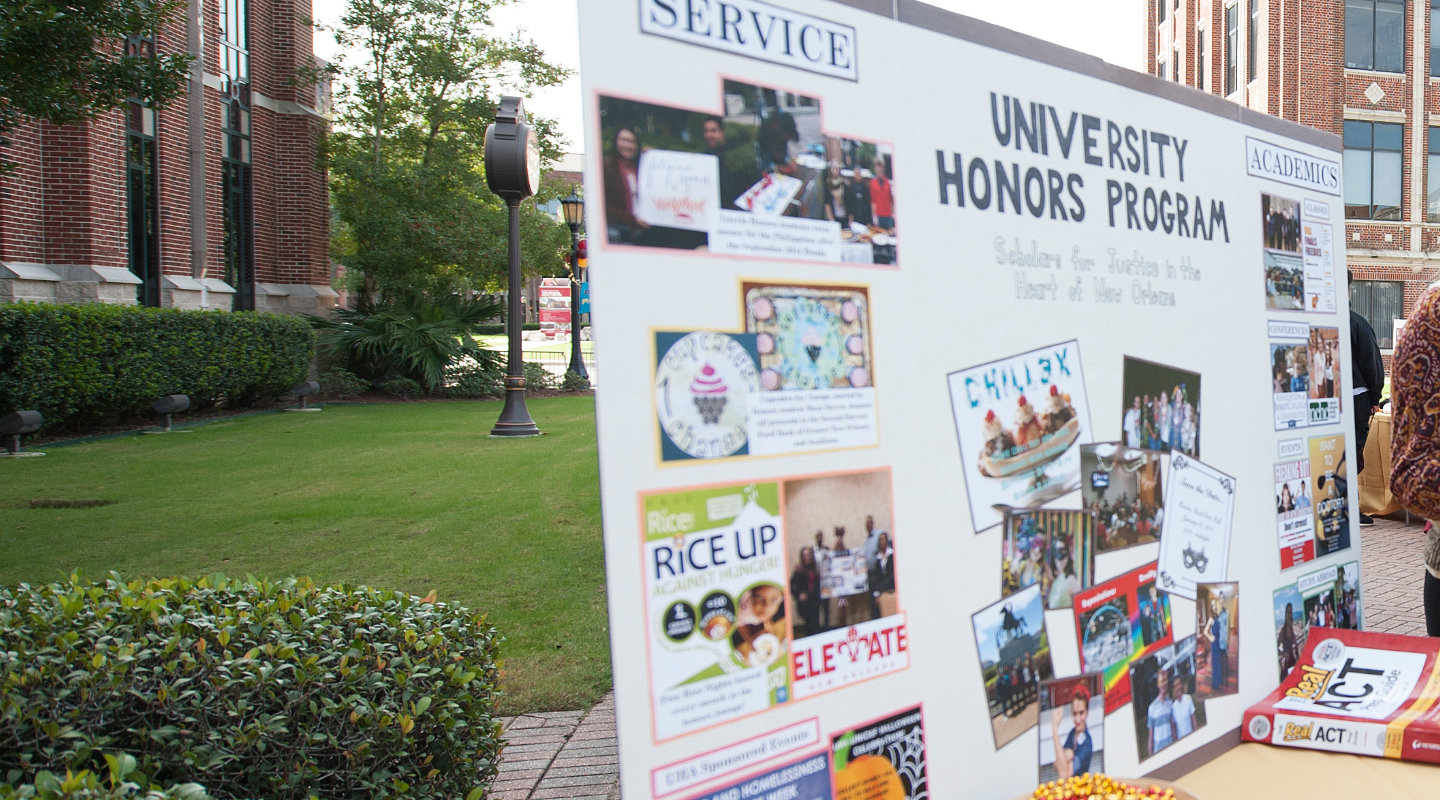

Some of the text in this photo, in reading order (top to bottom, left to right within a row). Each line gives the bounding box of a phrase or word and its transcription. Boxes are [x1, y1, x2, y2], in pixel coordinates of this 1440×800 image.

[650, 0, 851, 70] SERVICE
[990, 92, 1189, 182] UNIVERSITY
[1251, 146, 1338, 189] ACADEMICS
[936, 150, 1230, 243] HONORS PROGRAM
[993, 236, 1062, 269] Scholars
[1071, 244, 1095, 272] for
[1107, 247, 1159, 277] Justice
[1014, 271, 1058, 301] Heart
[1094, 277, 1122, 304] New
[736, 524, 777, 560] UP
[1285, 664, 1331, 700] Real
[1314, 658, 1385, 712] ACT
[1285, 721, 1315, 739] Real
[1315, 725, 1347, 744] ACT
[741, 756, 827, 797] HOMELESSNESS
